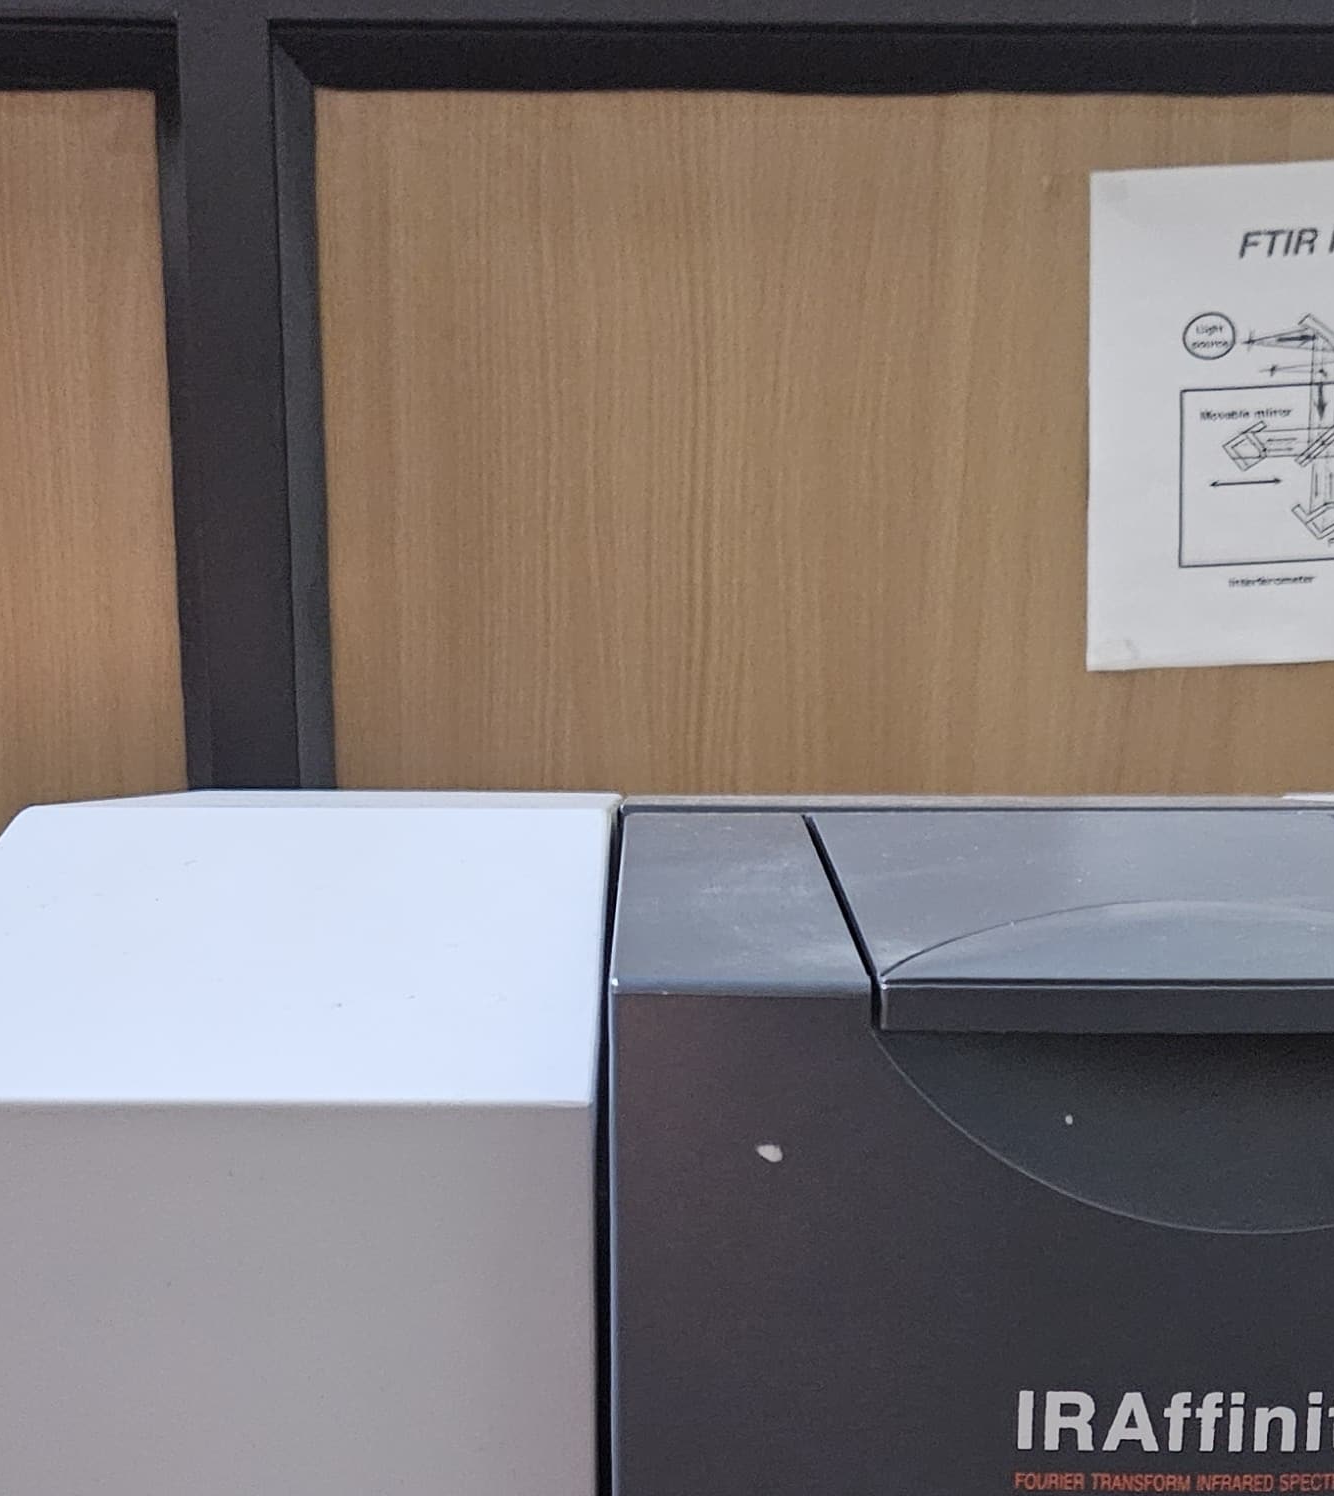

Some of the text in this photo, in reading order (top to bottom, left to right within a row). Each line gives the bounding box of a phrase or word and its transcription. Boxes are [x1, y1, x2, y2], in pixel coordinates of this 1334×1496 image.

[1237, 226, 1319, 259] FTIR
[1014, 1471, 1085, 1492] FOURIER
[1091, 1471, 1191, 1493] TRANSFORM
[1196, 1473, 1274, 1492] INFRARED
